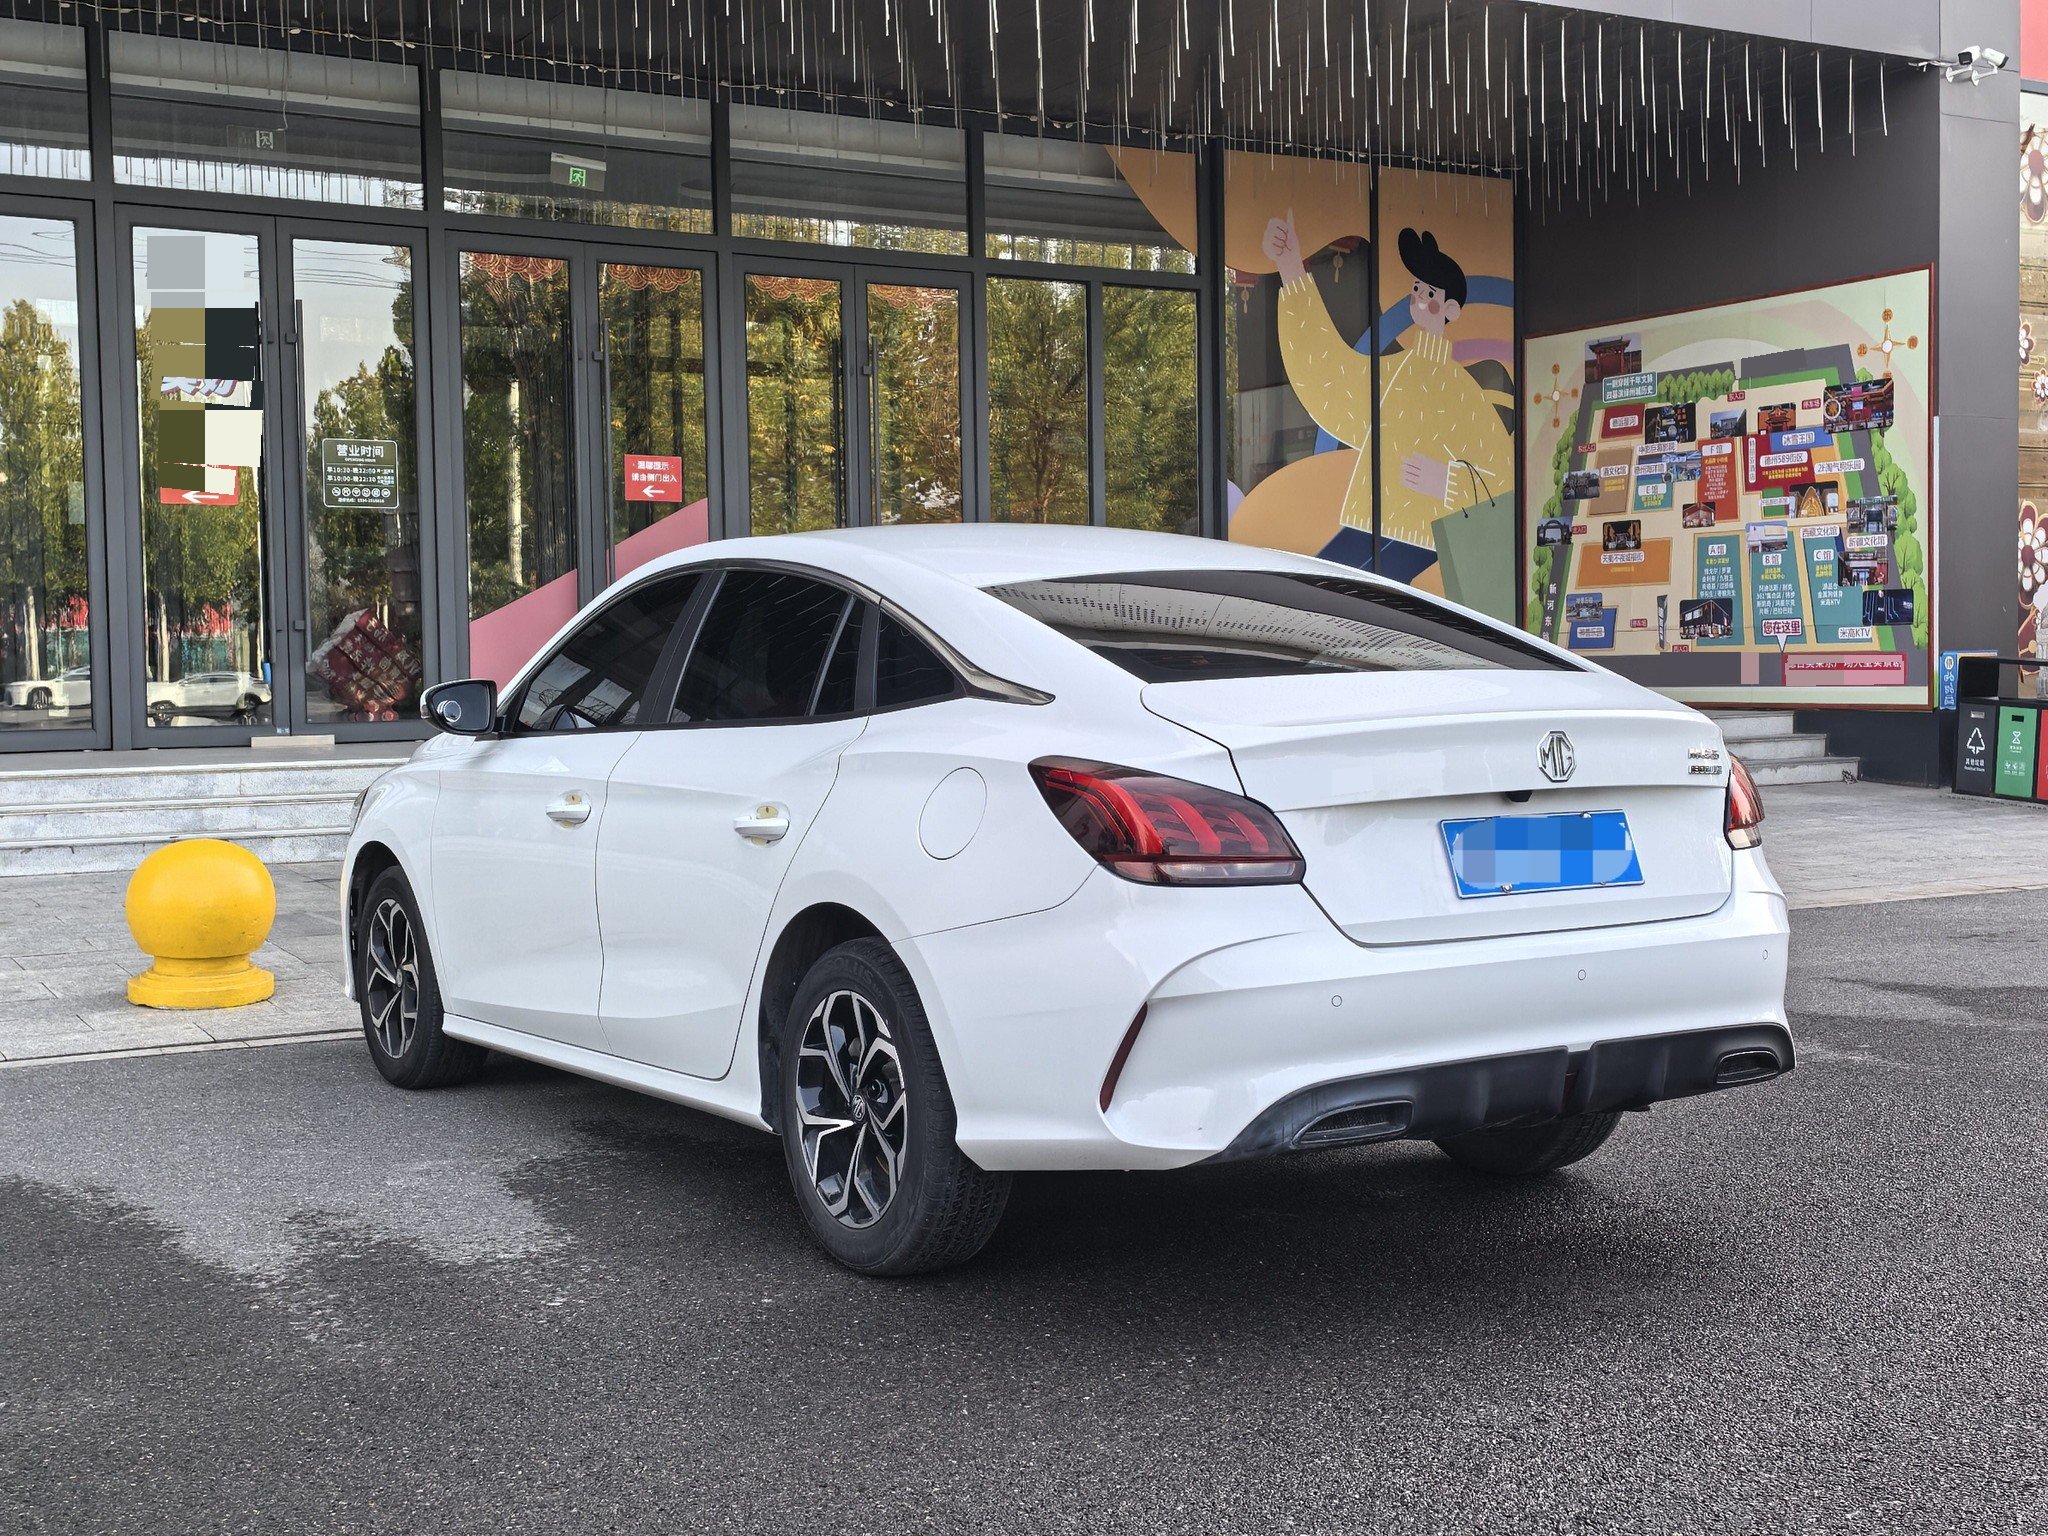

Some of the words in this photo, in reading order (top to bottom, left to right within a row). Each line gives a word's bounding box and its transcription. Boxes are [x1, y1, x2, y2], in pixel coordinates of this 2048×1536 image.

[337, 444, 384, 457] 营业时间
[638, 460, 669, 470] 温馨提示
[632, 473, 677, 482] 请由侧门出入
[1848, 536, 1887, 547] 新疆文化馆
[1763, 620, 1801, 634] 您在这里
[1840, 627, 1871, 638] 米高KTV
[1540, 734, 1573, 778] MG
